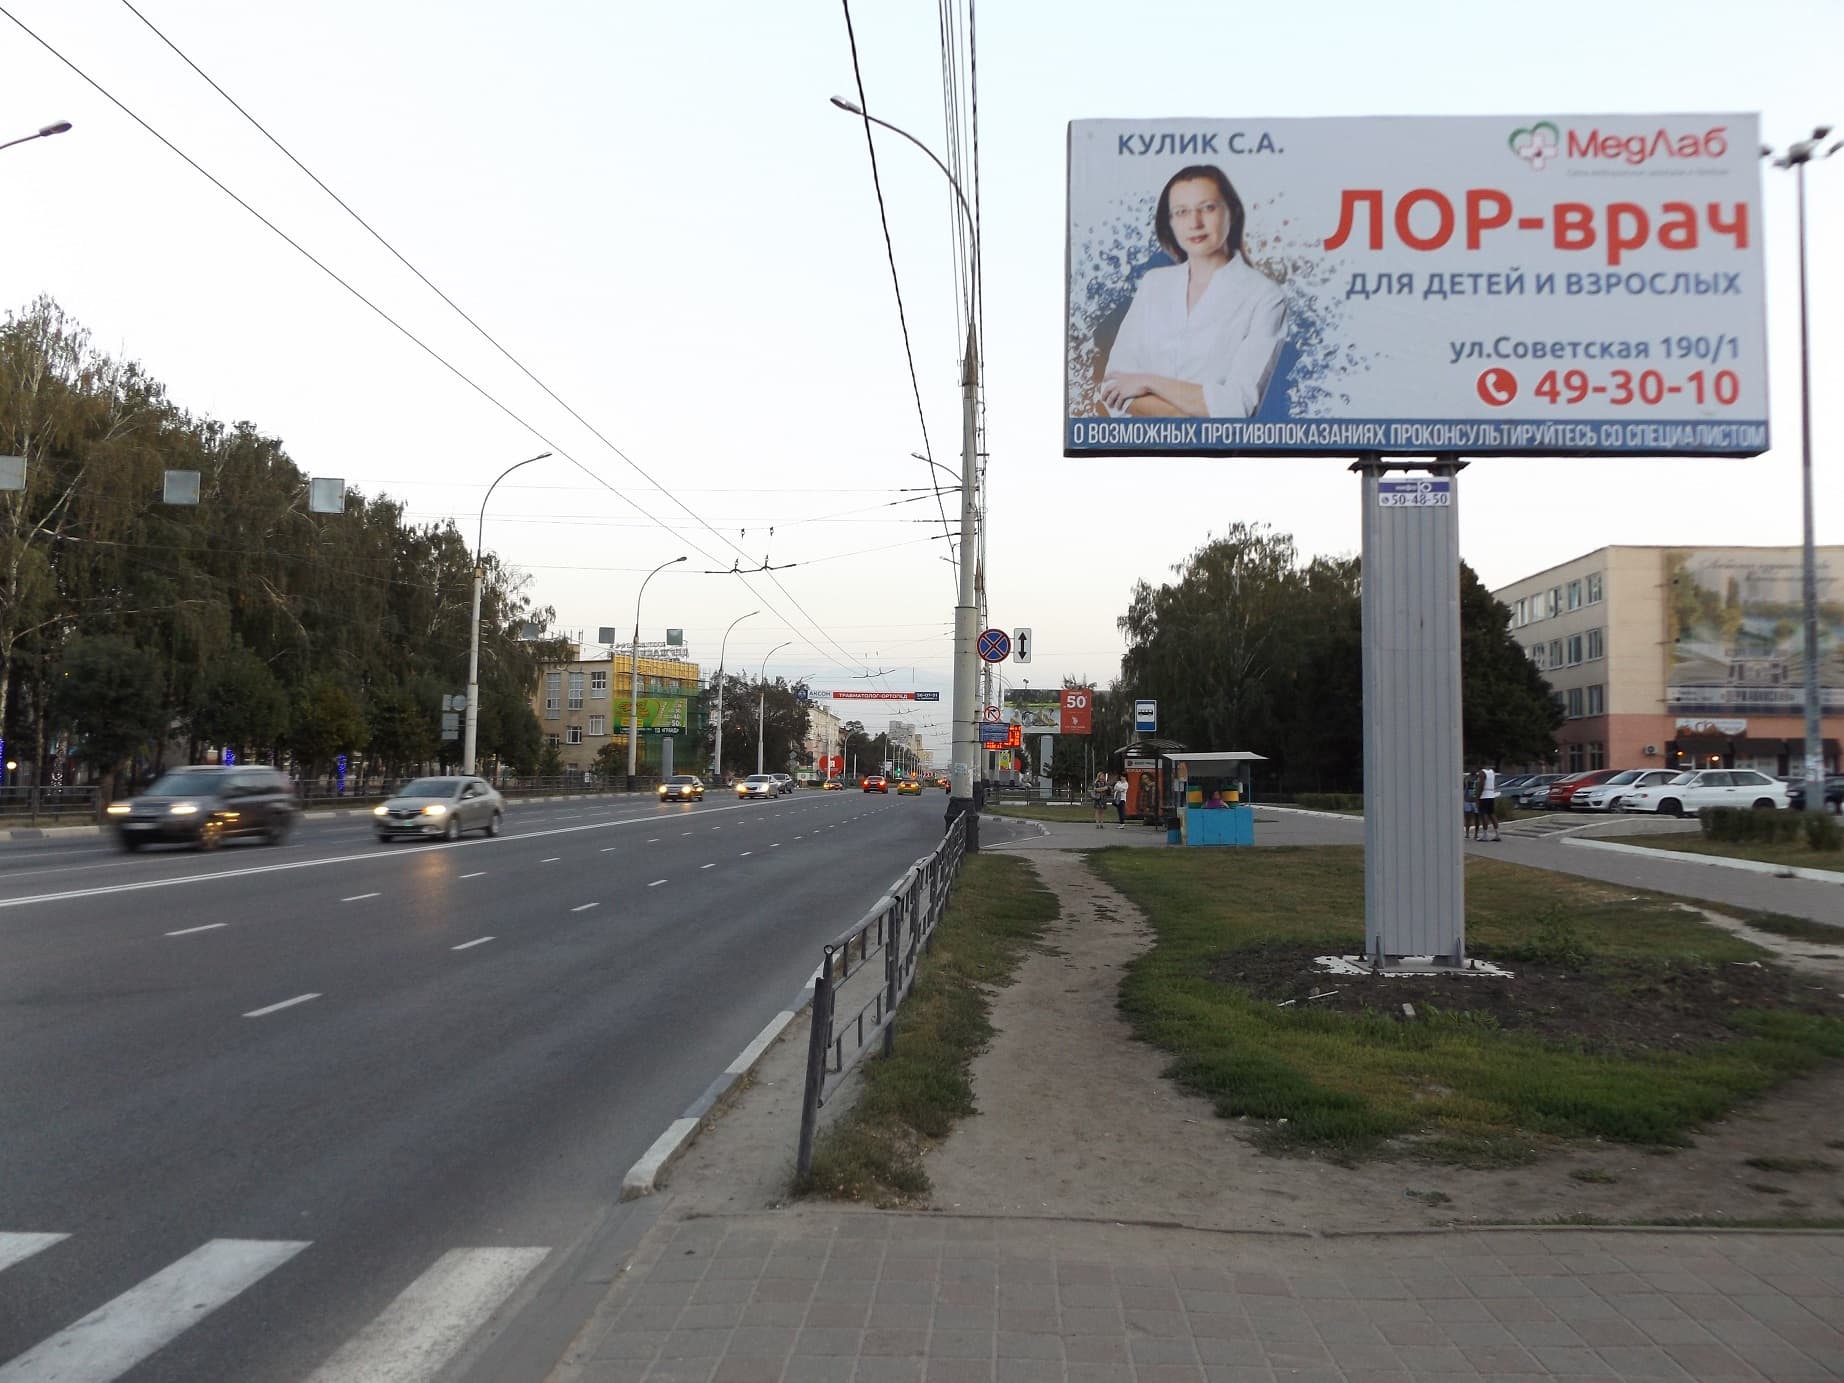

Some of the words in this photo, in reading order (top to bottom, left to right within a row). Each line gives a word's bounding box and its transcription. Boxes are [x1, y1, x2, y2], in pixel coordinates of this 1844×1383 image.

[1118, 134, 1219, 155] КУЛИК
[1229, 132, 1285, 154] С.А.
[1568, 126, 1728, 167] МедЛаб
[1323, 188, 1749, 266] ЛОР-врач
[1345, 272, 1414, 300] ДЛЯ
[1423, 267, 1524, 300] ДЕТЕЙ
[1535, 273, 1556, 294] И
[1565, 272, 1741, 296] ВЗРОСЛЫХ
[1449, 336, 1650, 364] ул.Советская
[1661, 335, 1740, 364] 190/1
[1534, 369, 1740, 406] 49-30-10
[1073, 424, 1084, 445] О
[1088, 423, 1197, 445] ВОЗМОЖНЫХ
[1202, 422, 1386, 446] ПРОТИВОПОКАЗАНИЯХ
[1390, 421, 1597, 447] ПРОКОНСУЛЬТИРУЙТЕСЬ
[1600, 425, 1623, 447] СО
[1627, 424, 1765, 448] СПЕЦИАЛИСТОМ
[1392, 493, 1448, 505] 50-48-50
